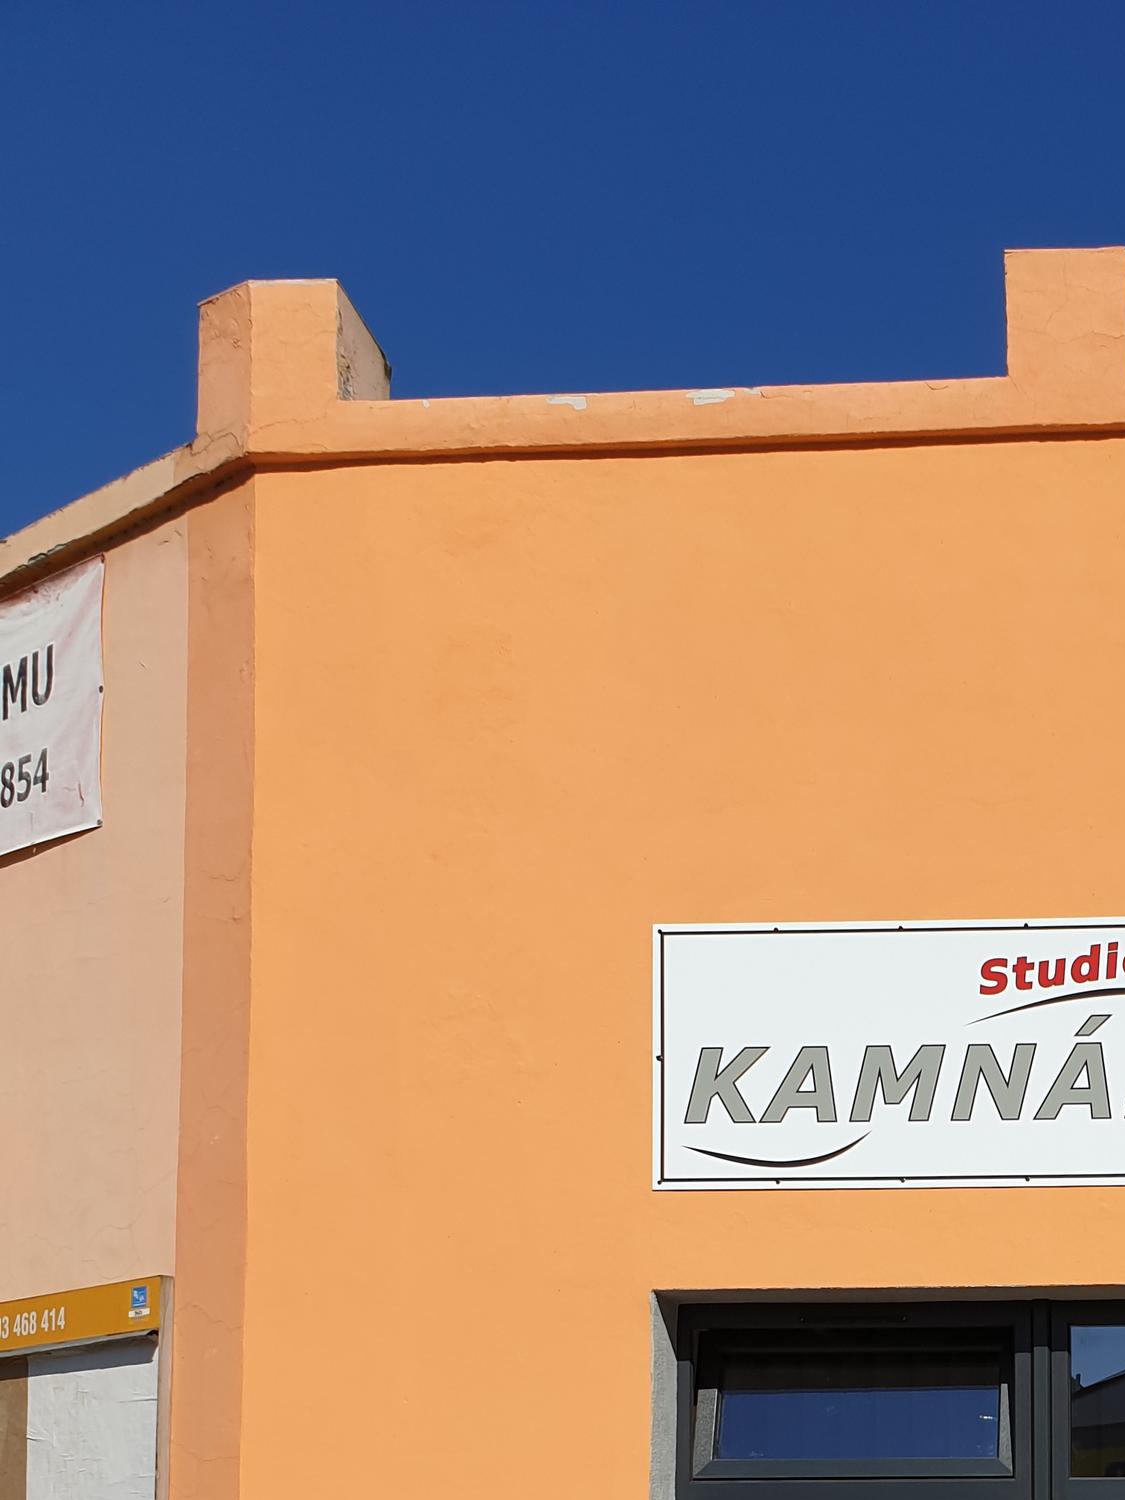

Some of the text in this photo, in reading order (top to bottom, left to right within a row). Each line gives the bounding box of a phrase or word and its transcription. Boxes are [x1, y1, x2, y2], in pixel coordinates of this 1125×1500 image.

[2, 644, 54, 720] MU
[0, 748, 49, 808] 854
[0, 1307, 65, 1339] 3 468 414
